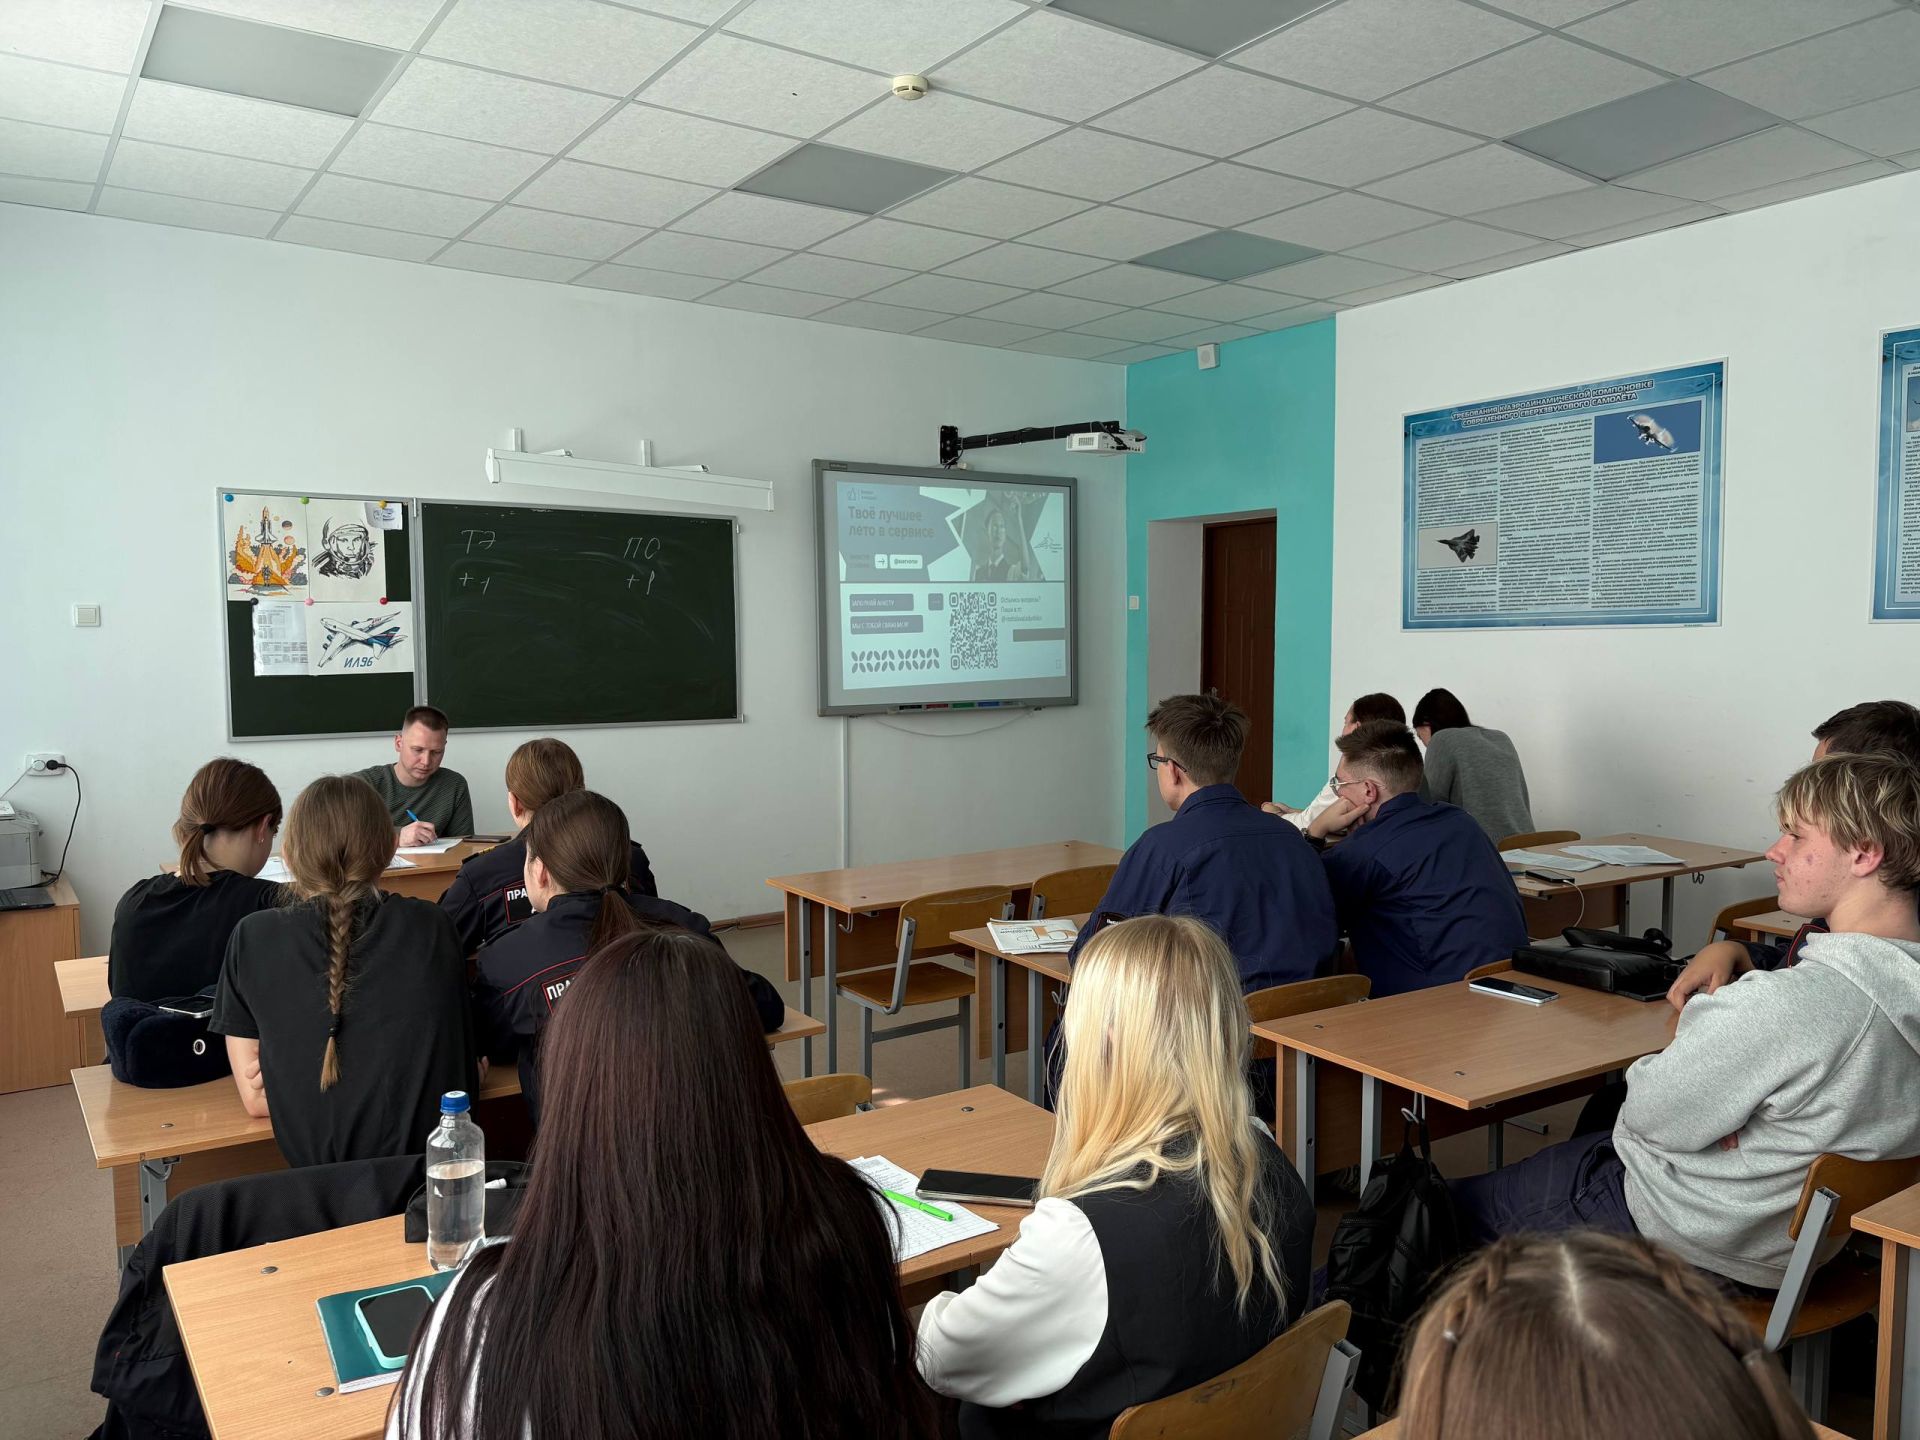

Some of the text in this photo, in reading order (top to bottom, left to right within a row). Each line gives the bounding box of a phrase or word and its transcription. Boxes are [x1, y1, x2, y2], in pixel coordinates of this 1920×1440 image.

[1452, 406, 1498, 420] ТРЕБОВАНИЯ
[1506, 390, 1591, 410] АЭРОДИНАМИЧЕСКОЙ
[1592, 380, 1653, 396] КОМПОНОВКЕ
[1462, 391, 1637, 426] СОВРЕМЕННОГО СВЕРХЗВУКОВОГО САМОЛЁТА
[848, 505, 922, 523] Твоё лучшее
[848, 525, 876, 537] лето
[888, 527, 935, 540] сервисе
